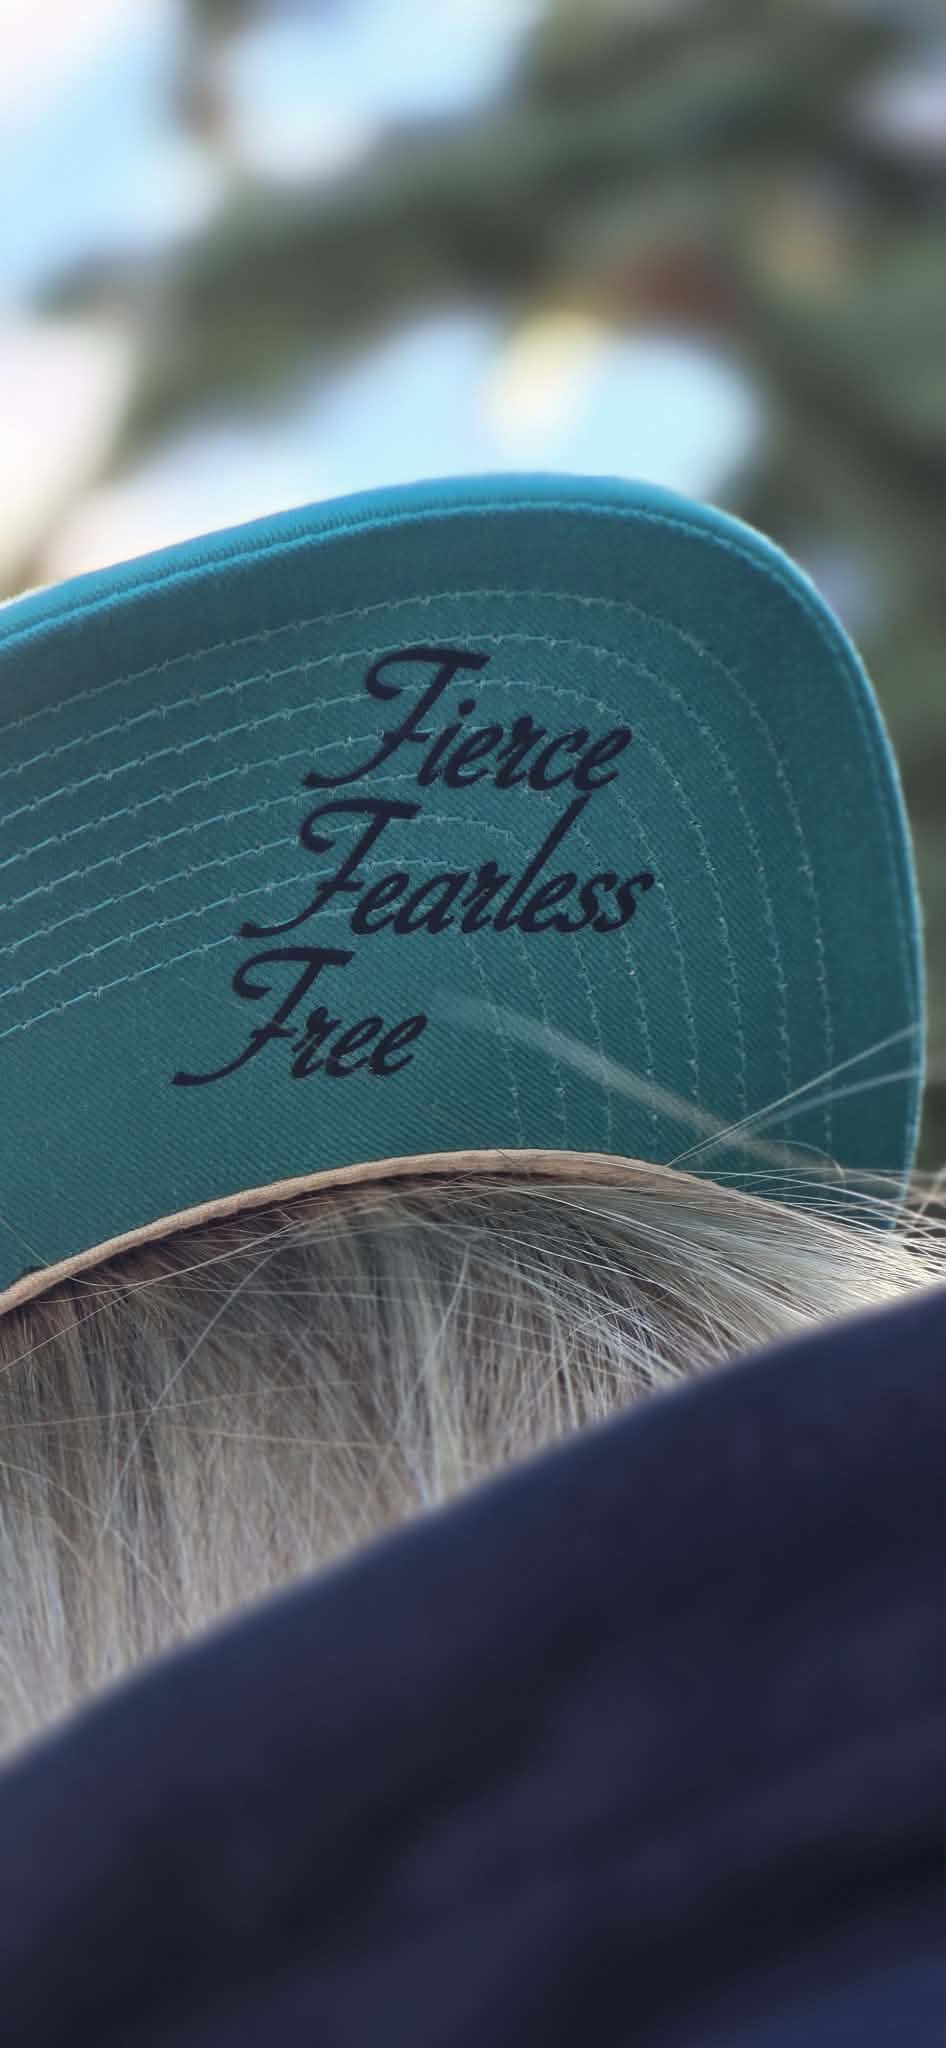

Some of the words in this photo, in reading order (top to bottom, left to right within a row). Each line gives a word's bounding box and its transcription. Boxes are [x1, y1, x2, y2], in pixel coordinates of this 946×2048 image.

[302, 646, 633, 791] Fierce
[237, 794, 655, 938] Fearless
[171, 946, 428, 1086] Free
